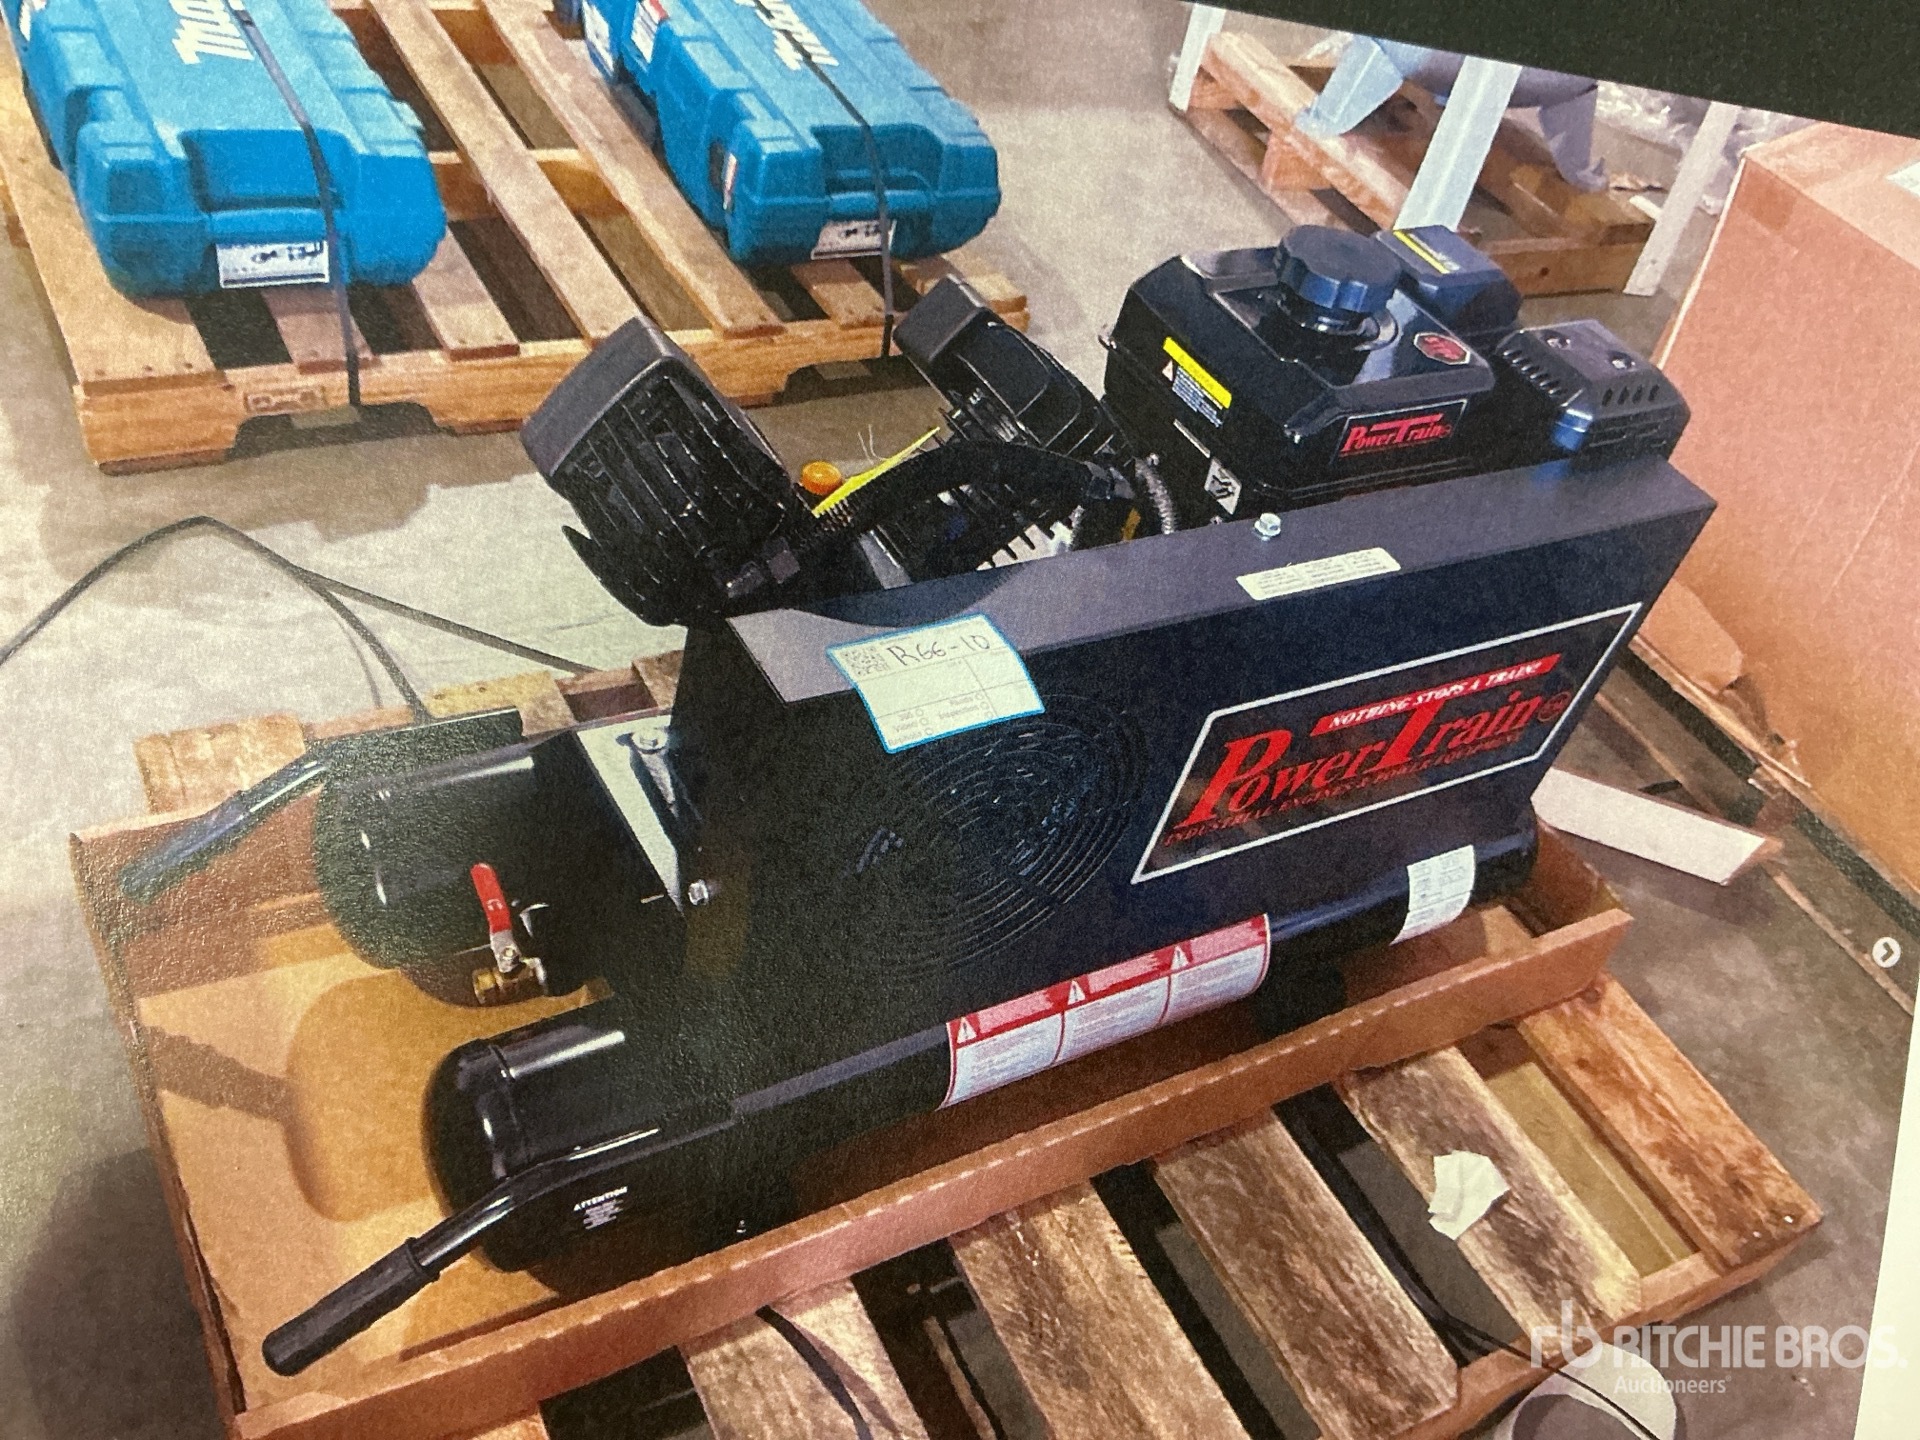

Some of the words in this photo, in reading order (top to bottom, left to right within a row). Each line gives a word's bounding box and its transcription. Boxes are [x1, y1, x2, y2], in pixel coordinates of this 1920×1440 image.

[1340, 413, 1445, 452] PowerTrain
[887, 634, 990, 666] R66-10
[1329, 697, 1412, 728] NOTHING
[1414, 682, 1468, 706] STOPS
[1469, 679, 1482, 691] A
[1174, 654, 1560, 829] PowerTrain
